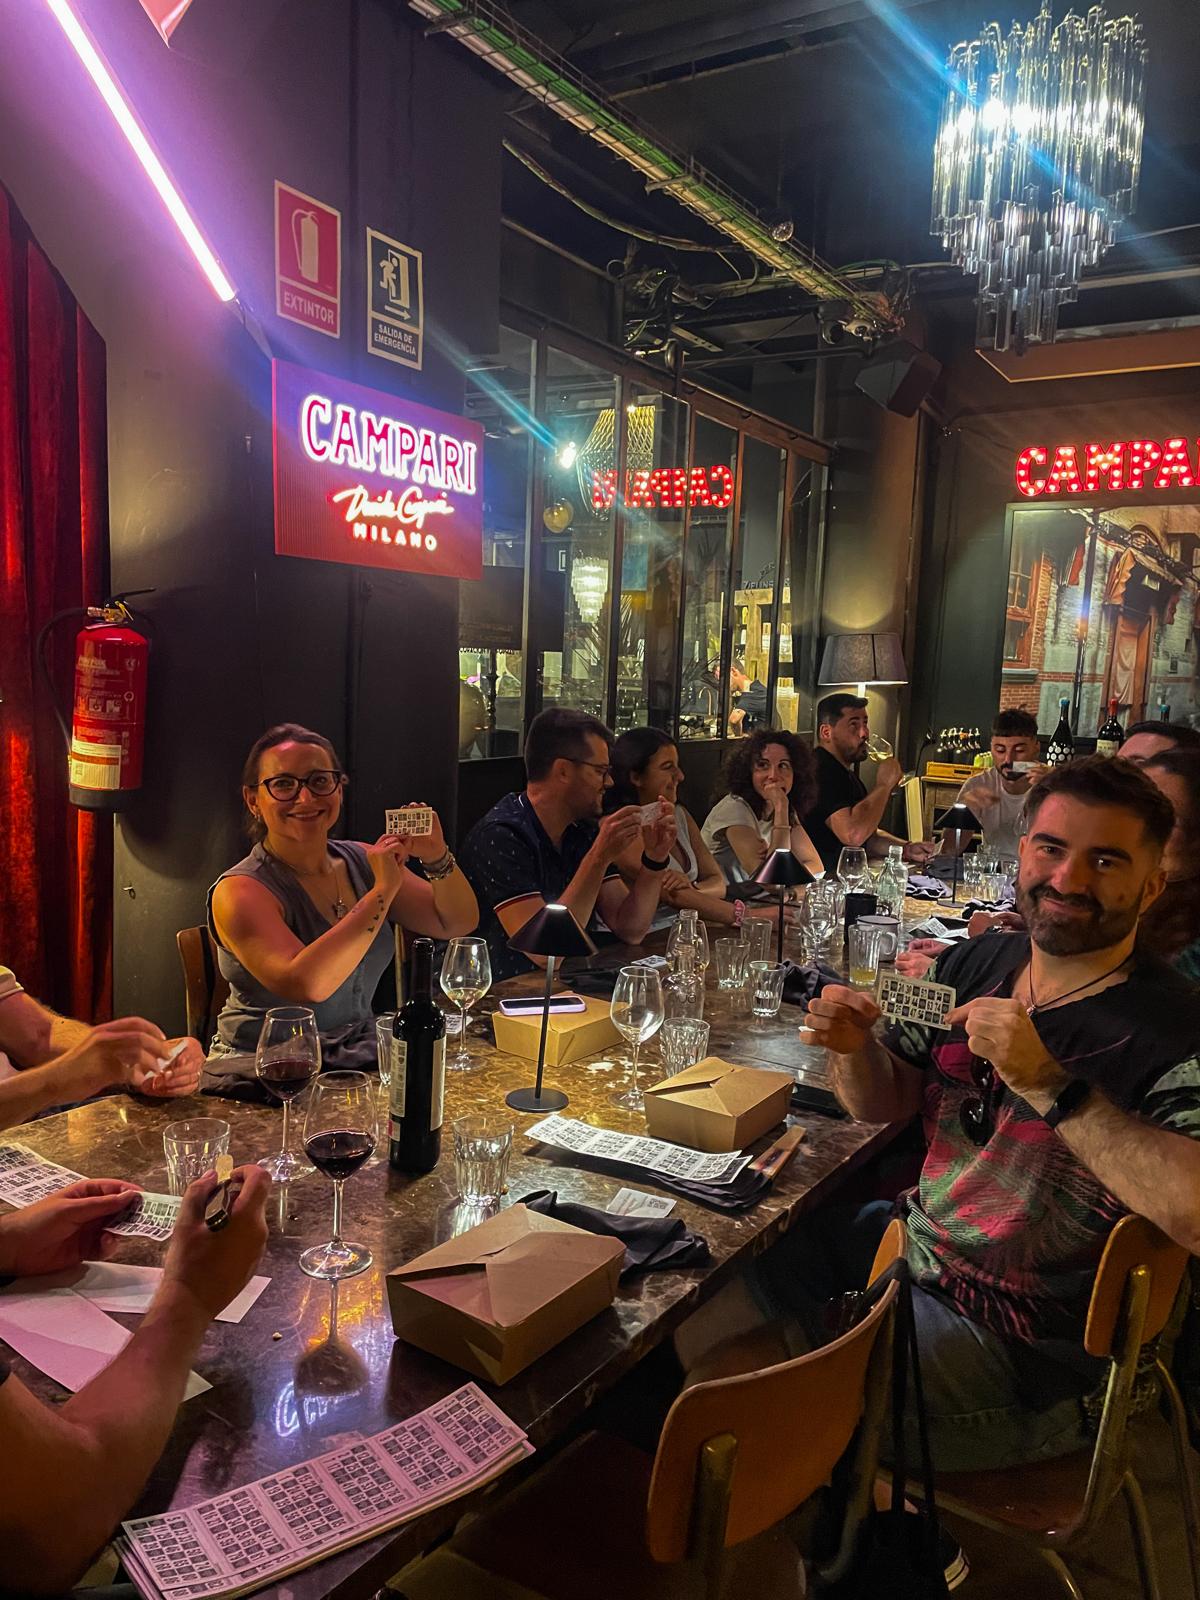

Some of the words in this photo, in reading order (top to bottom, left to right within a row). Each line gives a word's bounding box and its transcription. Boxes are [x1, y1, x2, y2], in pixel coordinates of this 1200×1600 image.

[284, 291, 334, 325] EXTINTOR
[374, 333, 417, 356] EMERGENCIA
[378, 324, 402, 340] SALIDA
[403, 333, 412, 344] DE
[302, 394, 477, 495] CAMPARI
[1015, 437, 1200, 497] CAMPA
[353, 522, 438, 551] MILANO
